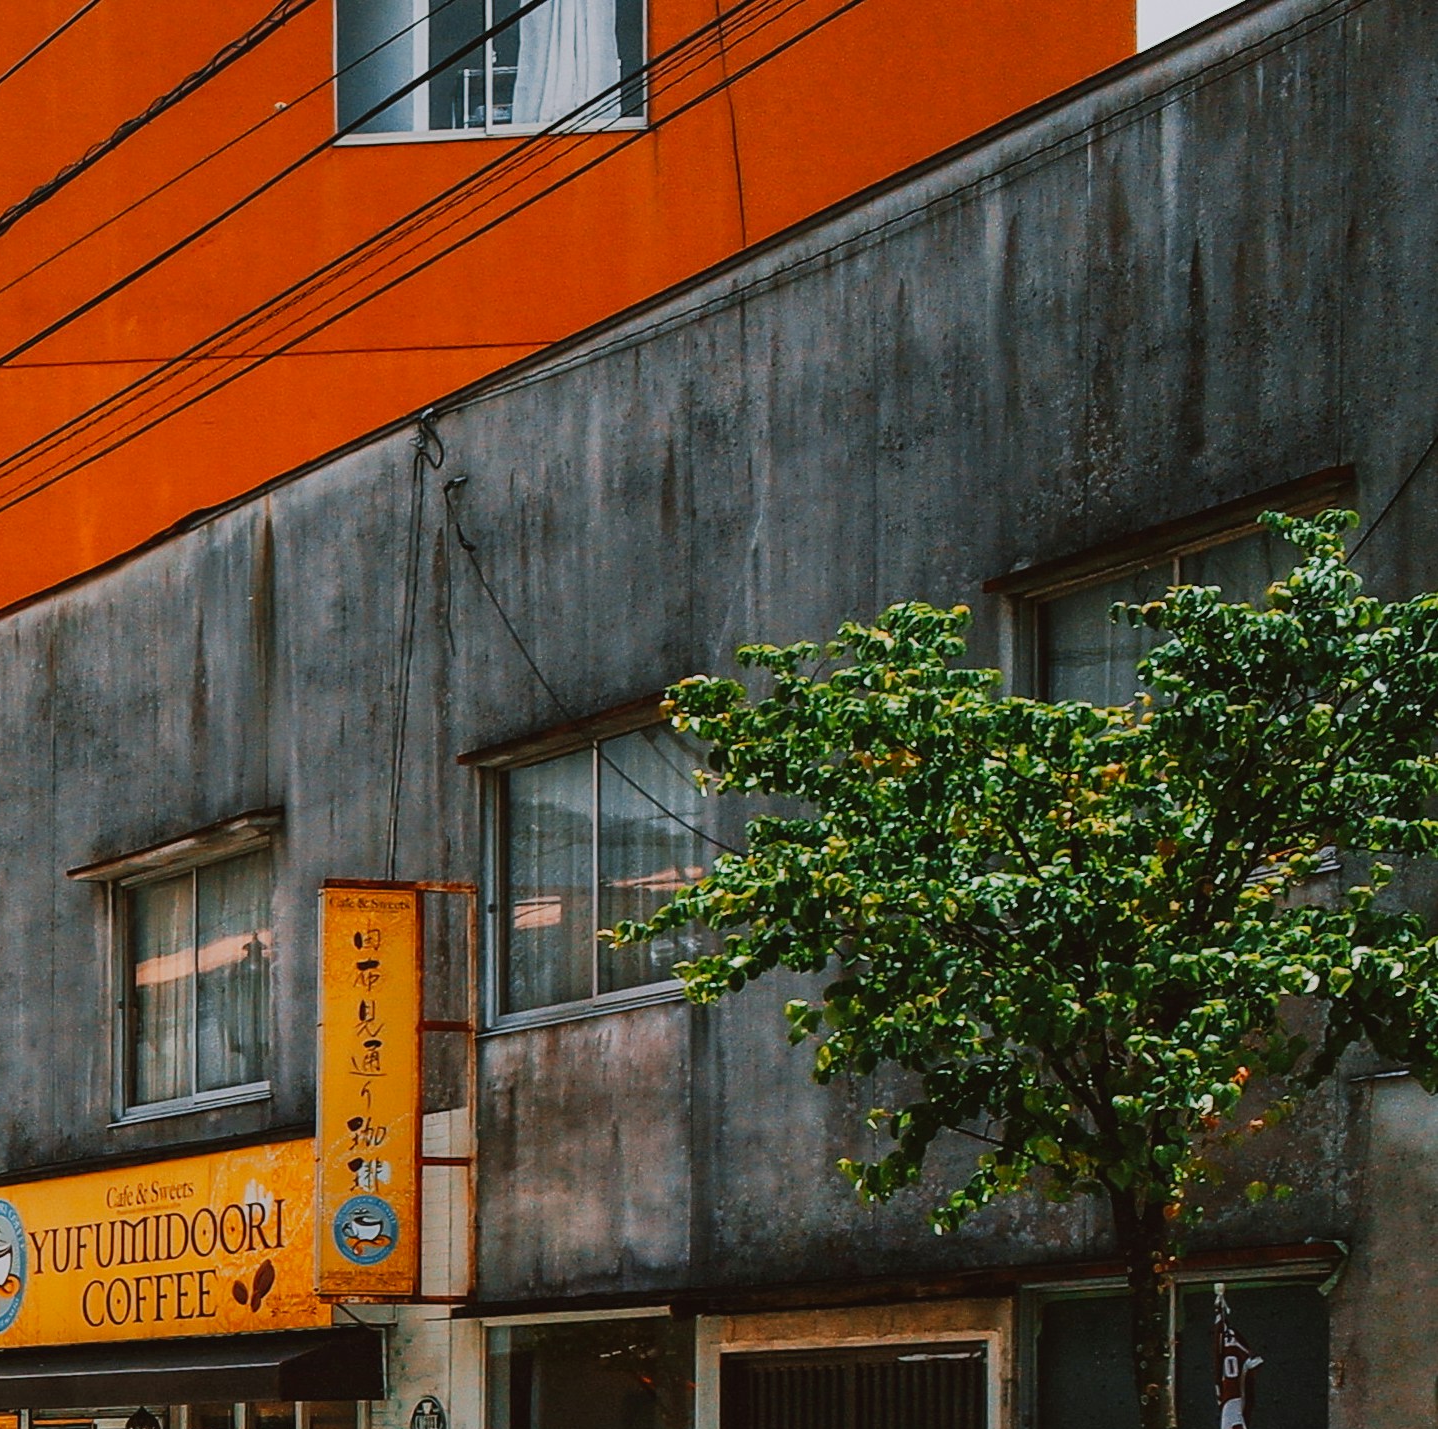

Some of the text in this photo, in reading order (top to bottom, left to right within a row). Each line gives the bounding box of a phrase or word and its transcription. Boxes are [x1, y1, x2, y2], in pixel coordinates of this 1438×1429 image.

[106, 1180, 194, 1209] Cafe & Sweets
[28, 1198, 286, 1275] YUFUMIDOORI
[82, 1268, 219, 1328] COFFEE
